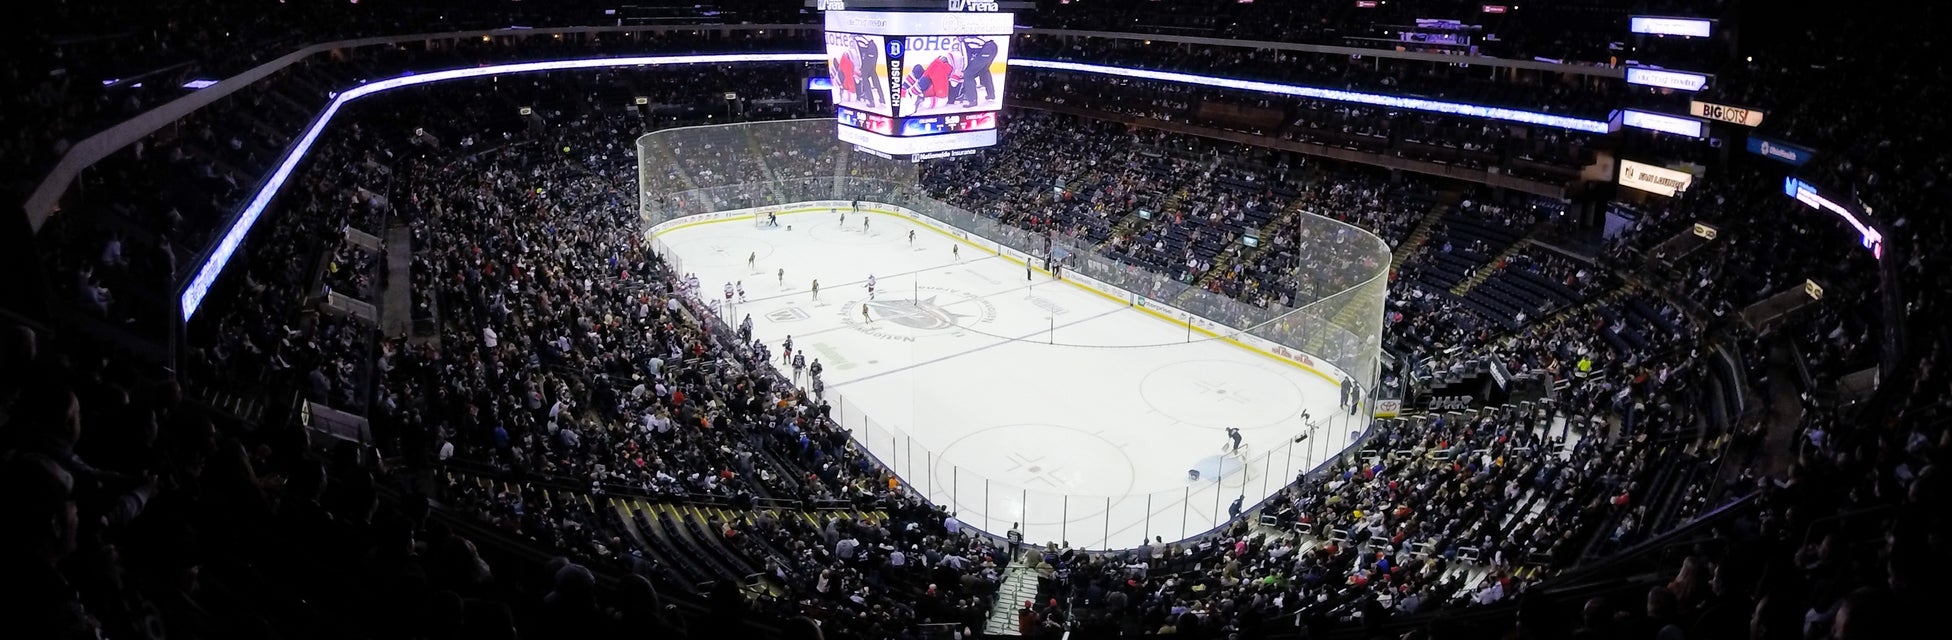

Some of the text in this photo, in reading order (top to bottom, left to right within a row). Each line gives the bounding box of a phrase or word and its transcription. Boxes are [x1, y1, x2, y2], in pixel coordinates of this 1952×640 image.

[891, 60, 900, 107] DISPATCH
[920, 149, 976, 160] Nationwide Insurance
